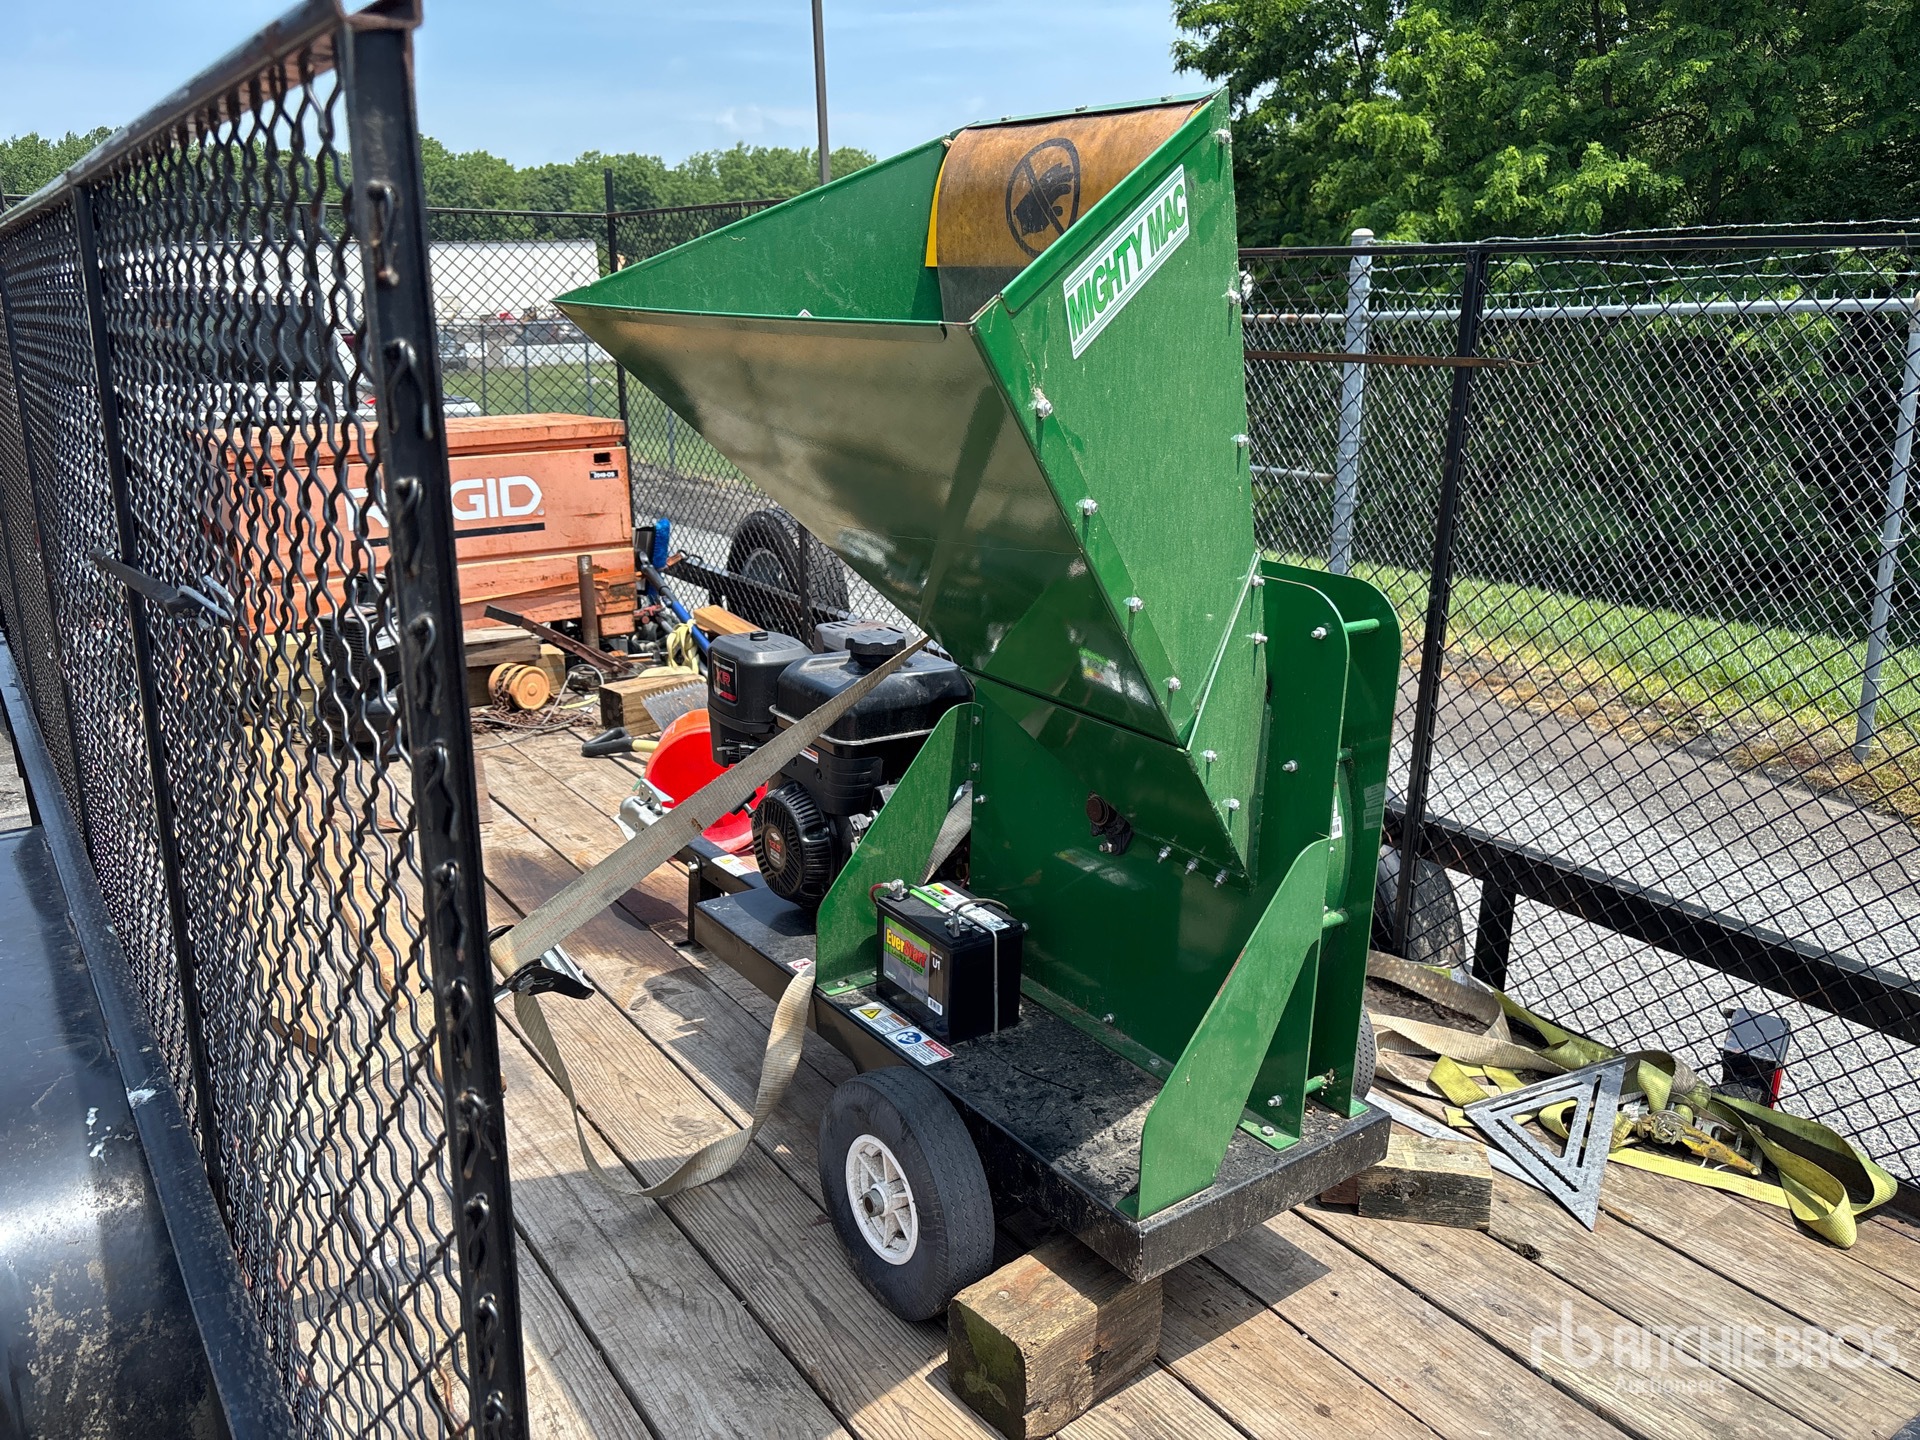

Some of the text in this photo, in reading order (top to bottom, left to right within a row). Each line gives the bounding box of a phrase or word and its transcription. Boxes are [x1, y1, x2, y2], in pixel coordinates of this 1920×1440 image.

[1067, 184, 1186, 342] MIGHTY MAC
[886, 928, 927, 967] EverStart
[932, 957, 940, 970] U1
